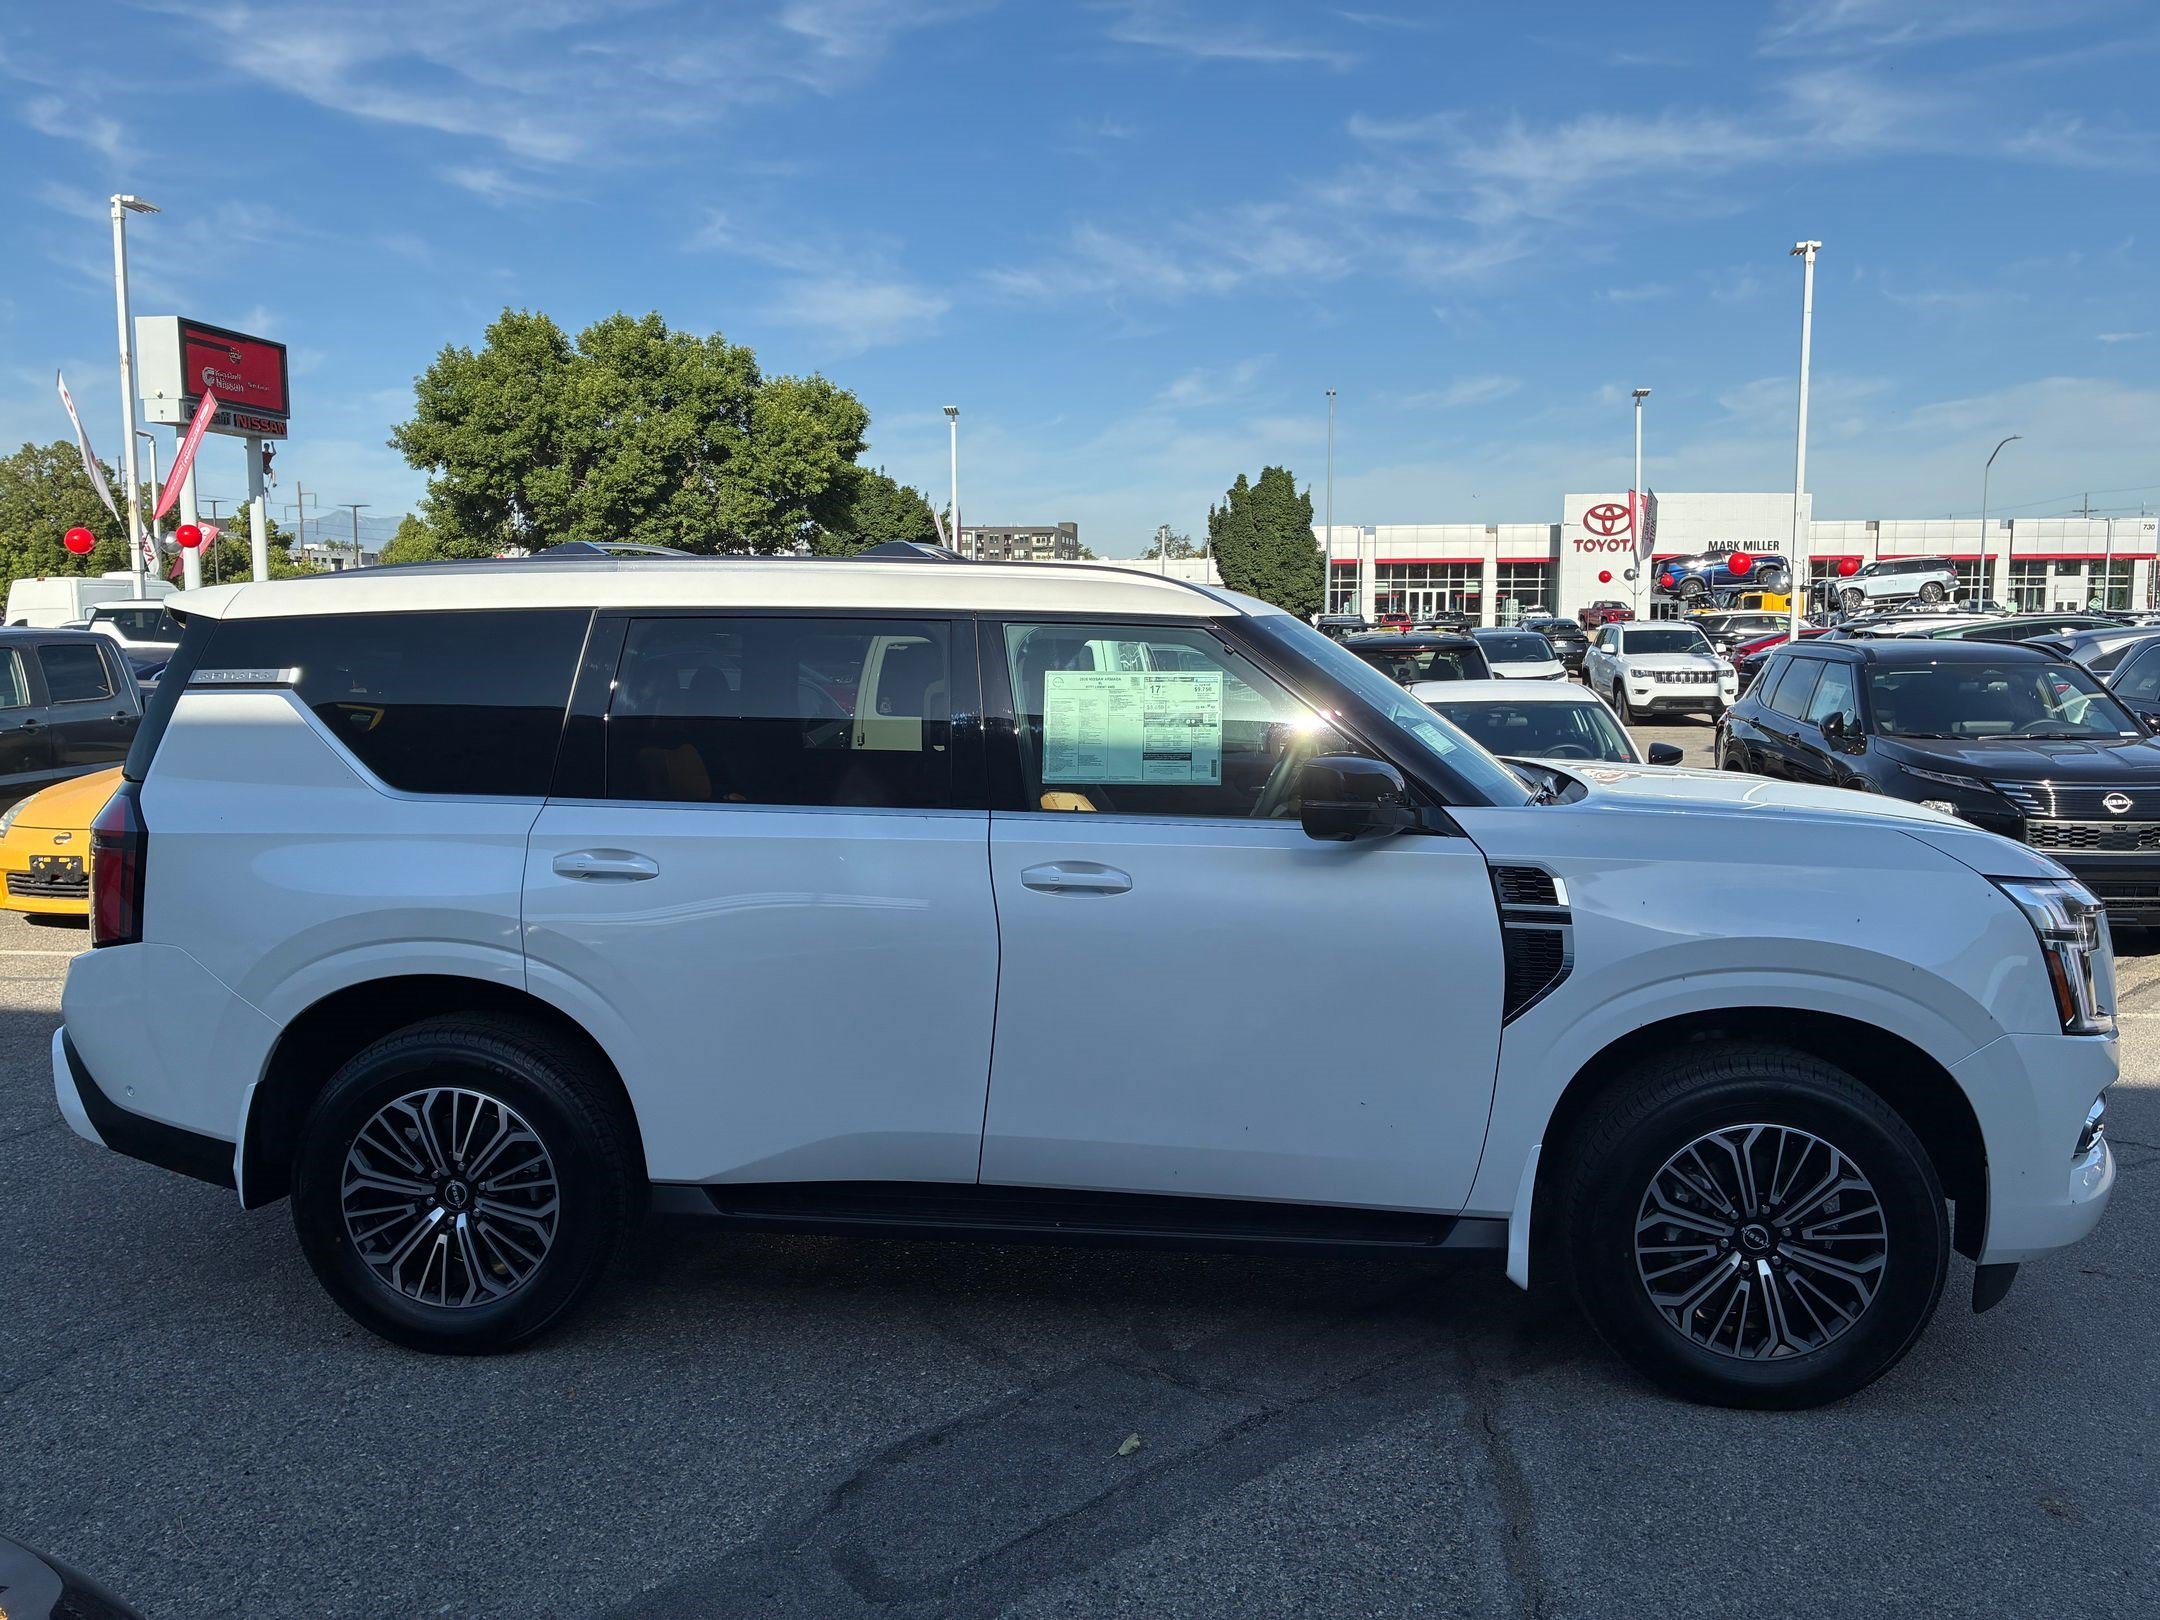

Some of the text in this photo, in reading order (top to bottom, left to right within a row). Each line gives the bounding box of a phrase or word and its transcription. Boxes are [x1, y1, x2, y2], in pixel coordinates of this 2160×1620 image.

[234, 414, 286, 435] NISSAN
[1708, 540, 1780, 552] MARK MILLER
[1150, 685, 1161, 694] 17
[1741, 1227, 1770, 1248] NISSAN
